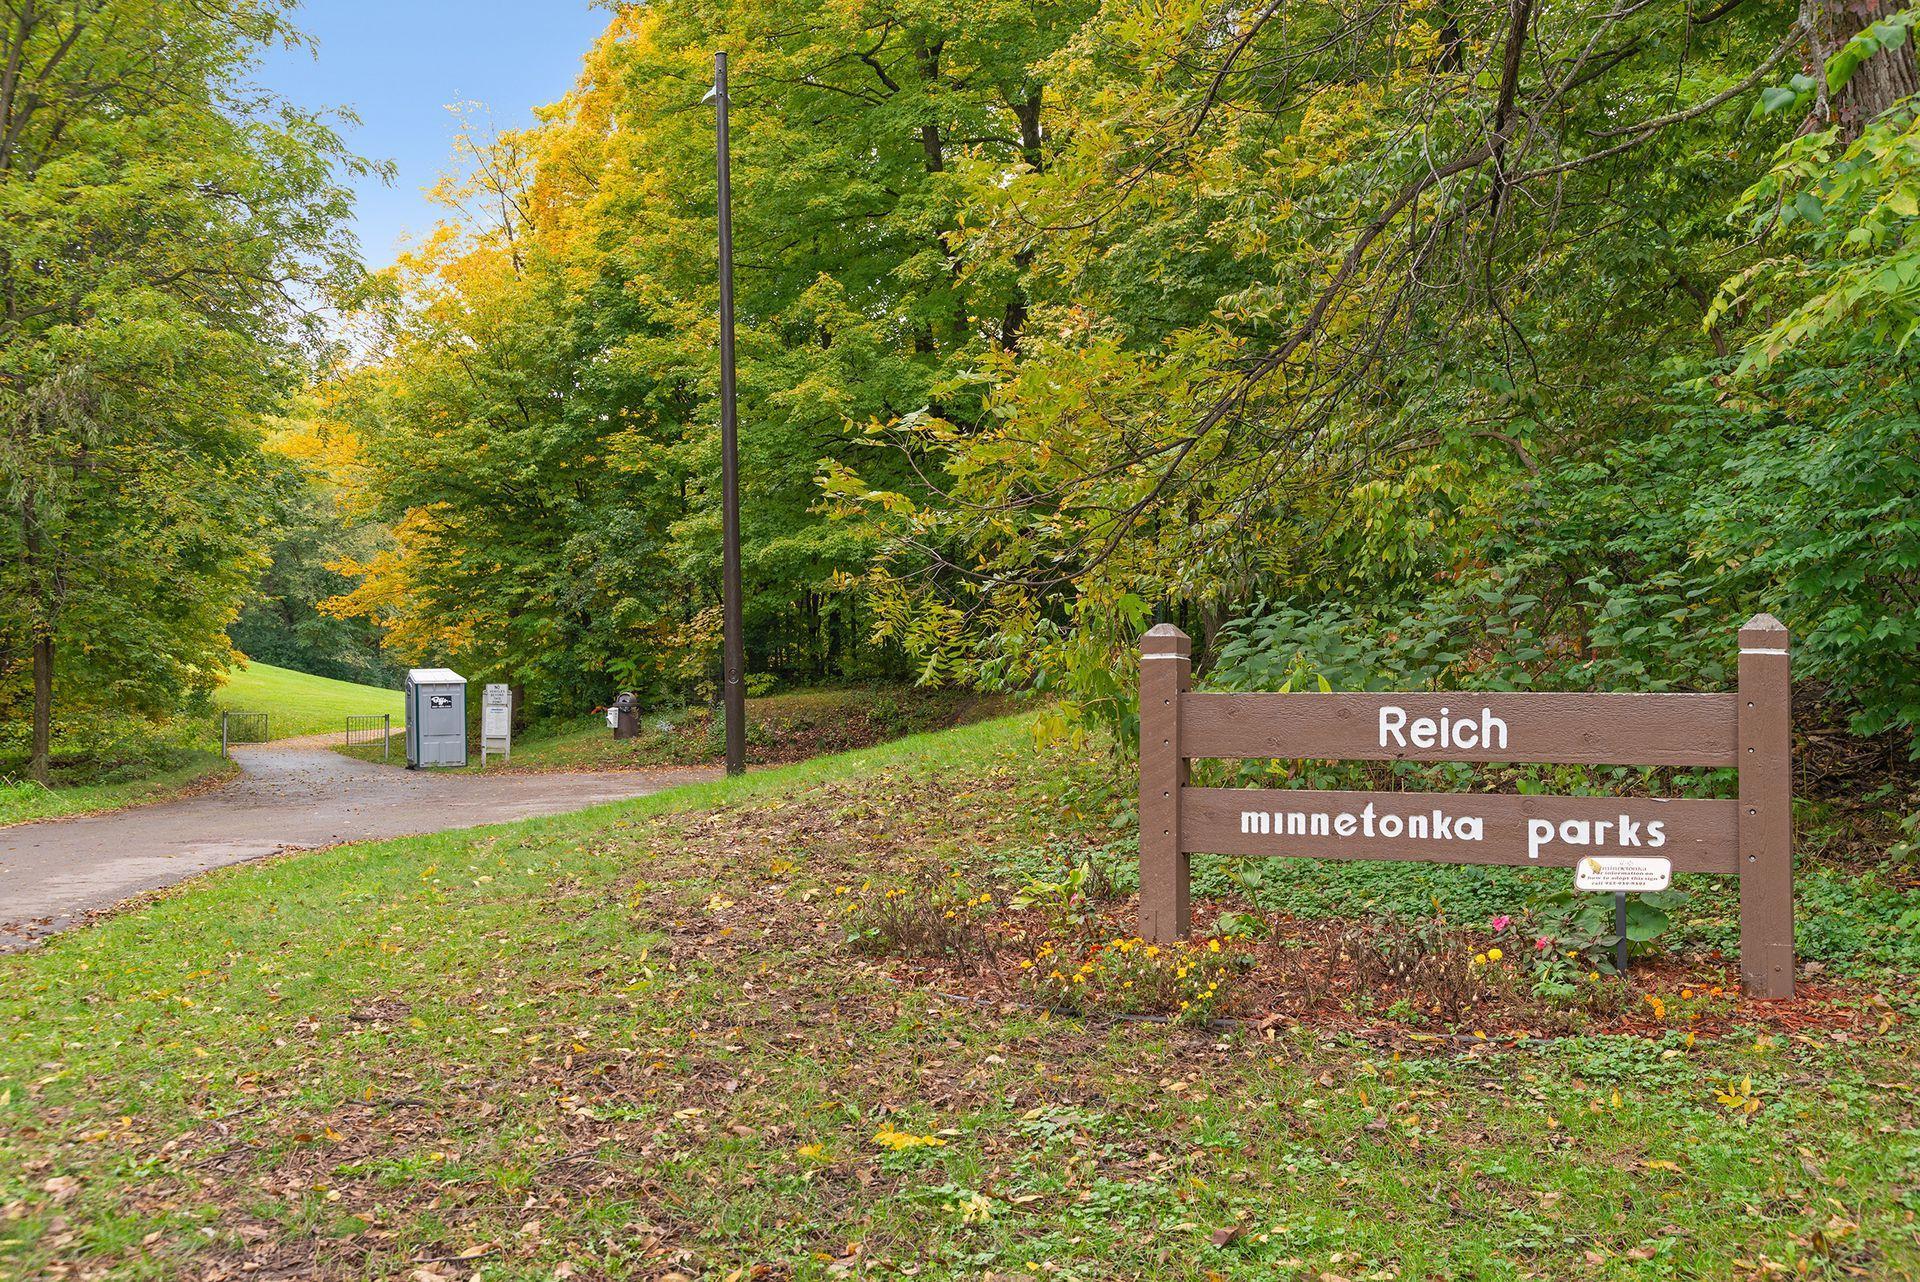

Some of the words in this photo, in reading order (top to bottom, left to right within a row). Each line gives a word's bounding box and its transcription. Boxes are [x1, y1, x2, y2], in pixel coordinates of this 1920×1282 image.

[1379, 706, 1508, 749] Reich
[1240, 802, 1483, 841] minnetonka
[1527, 815, 1666, 859] parks
